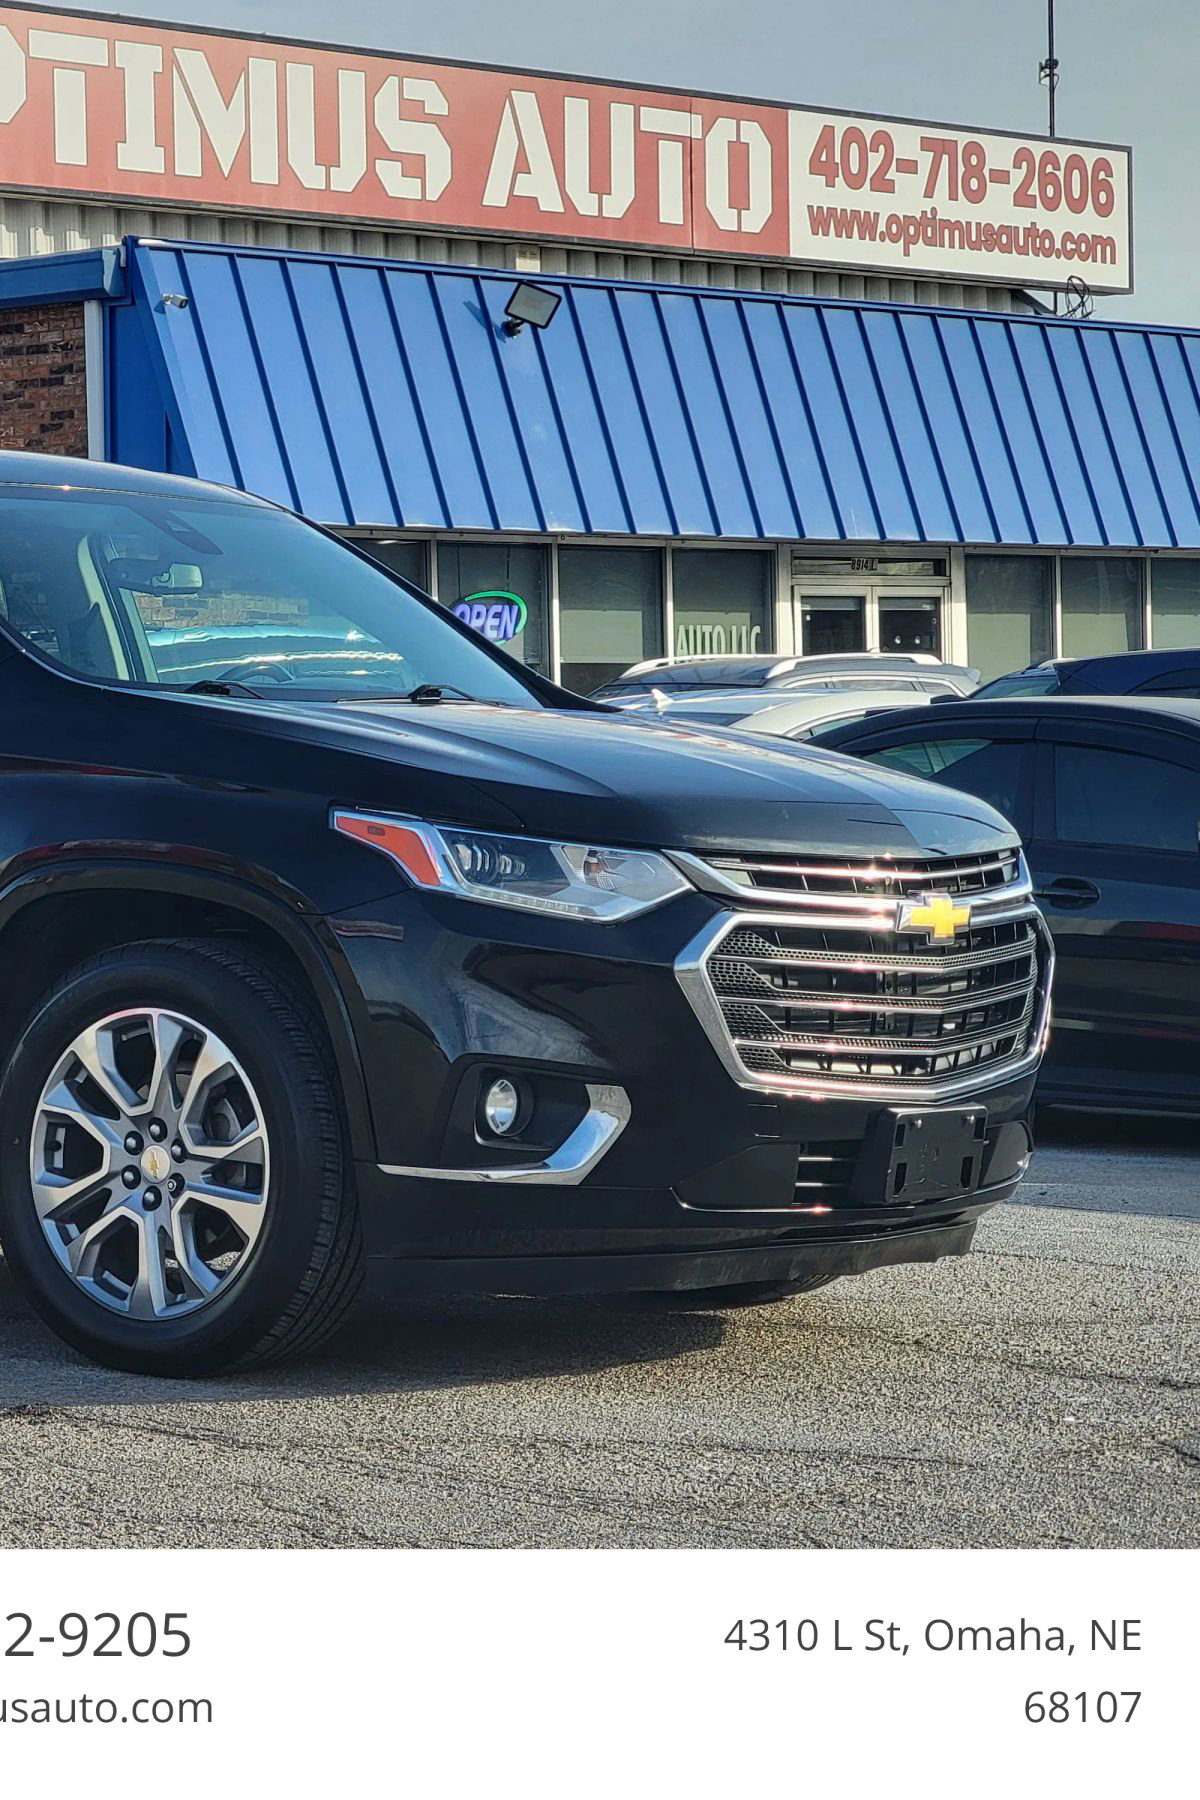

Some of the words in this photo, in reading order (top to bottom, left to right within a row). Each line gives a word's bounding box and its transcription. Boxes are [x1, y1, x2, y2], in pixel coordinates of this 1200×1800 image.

[481, 88, 772, 234] AUTO
[808, 124, 1115, 218] 402-718-2606
[806, 204, 1117, 265] www.optimusauto.com
